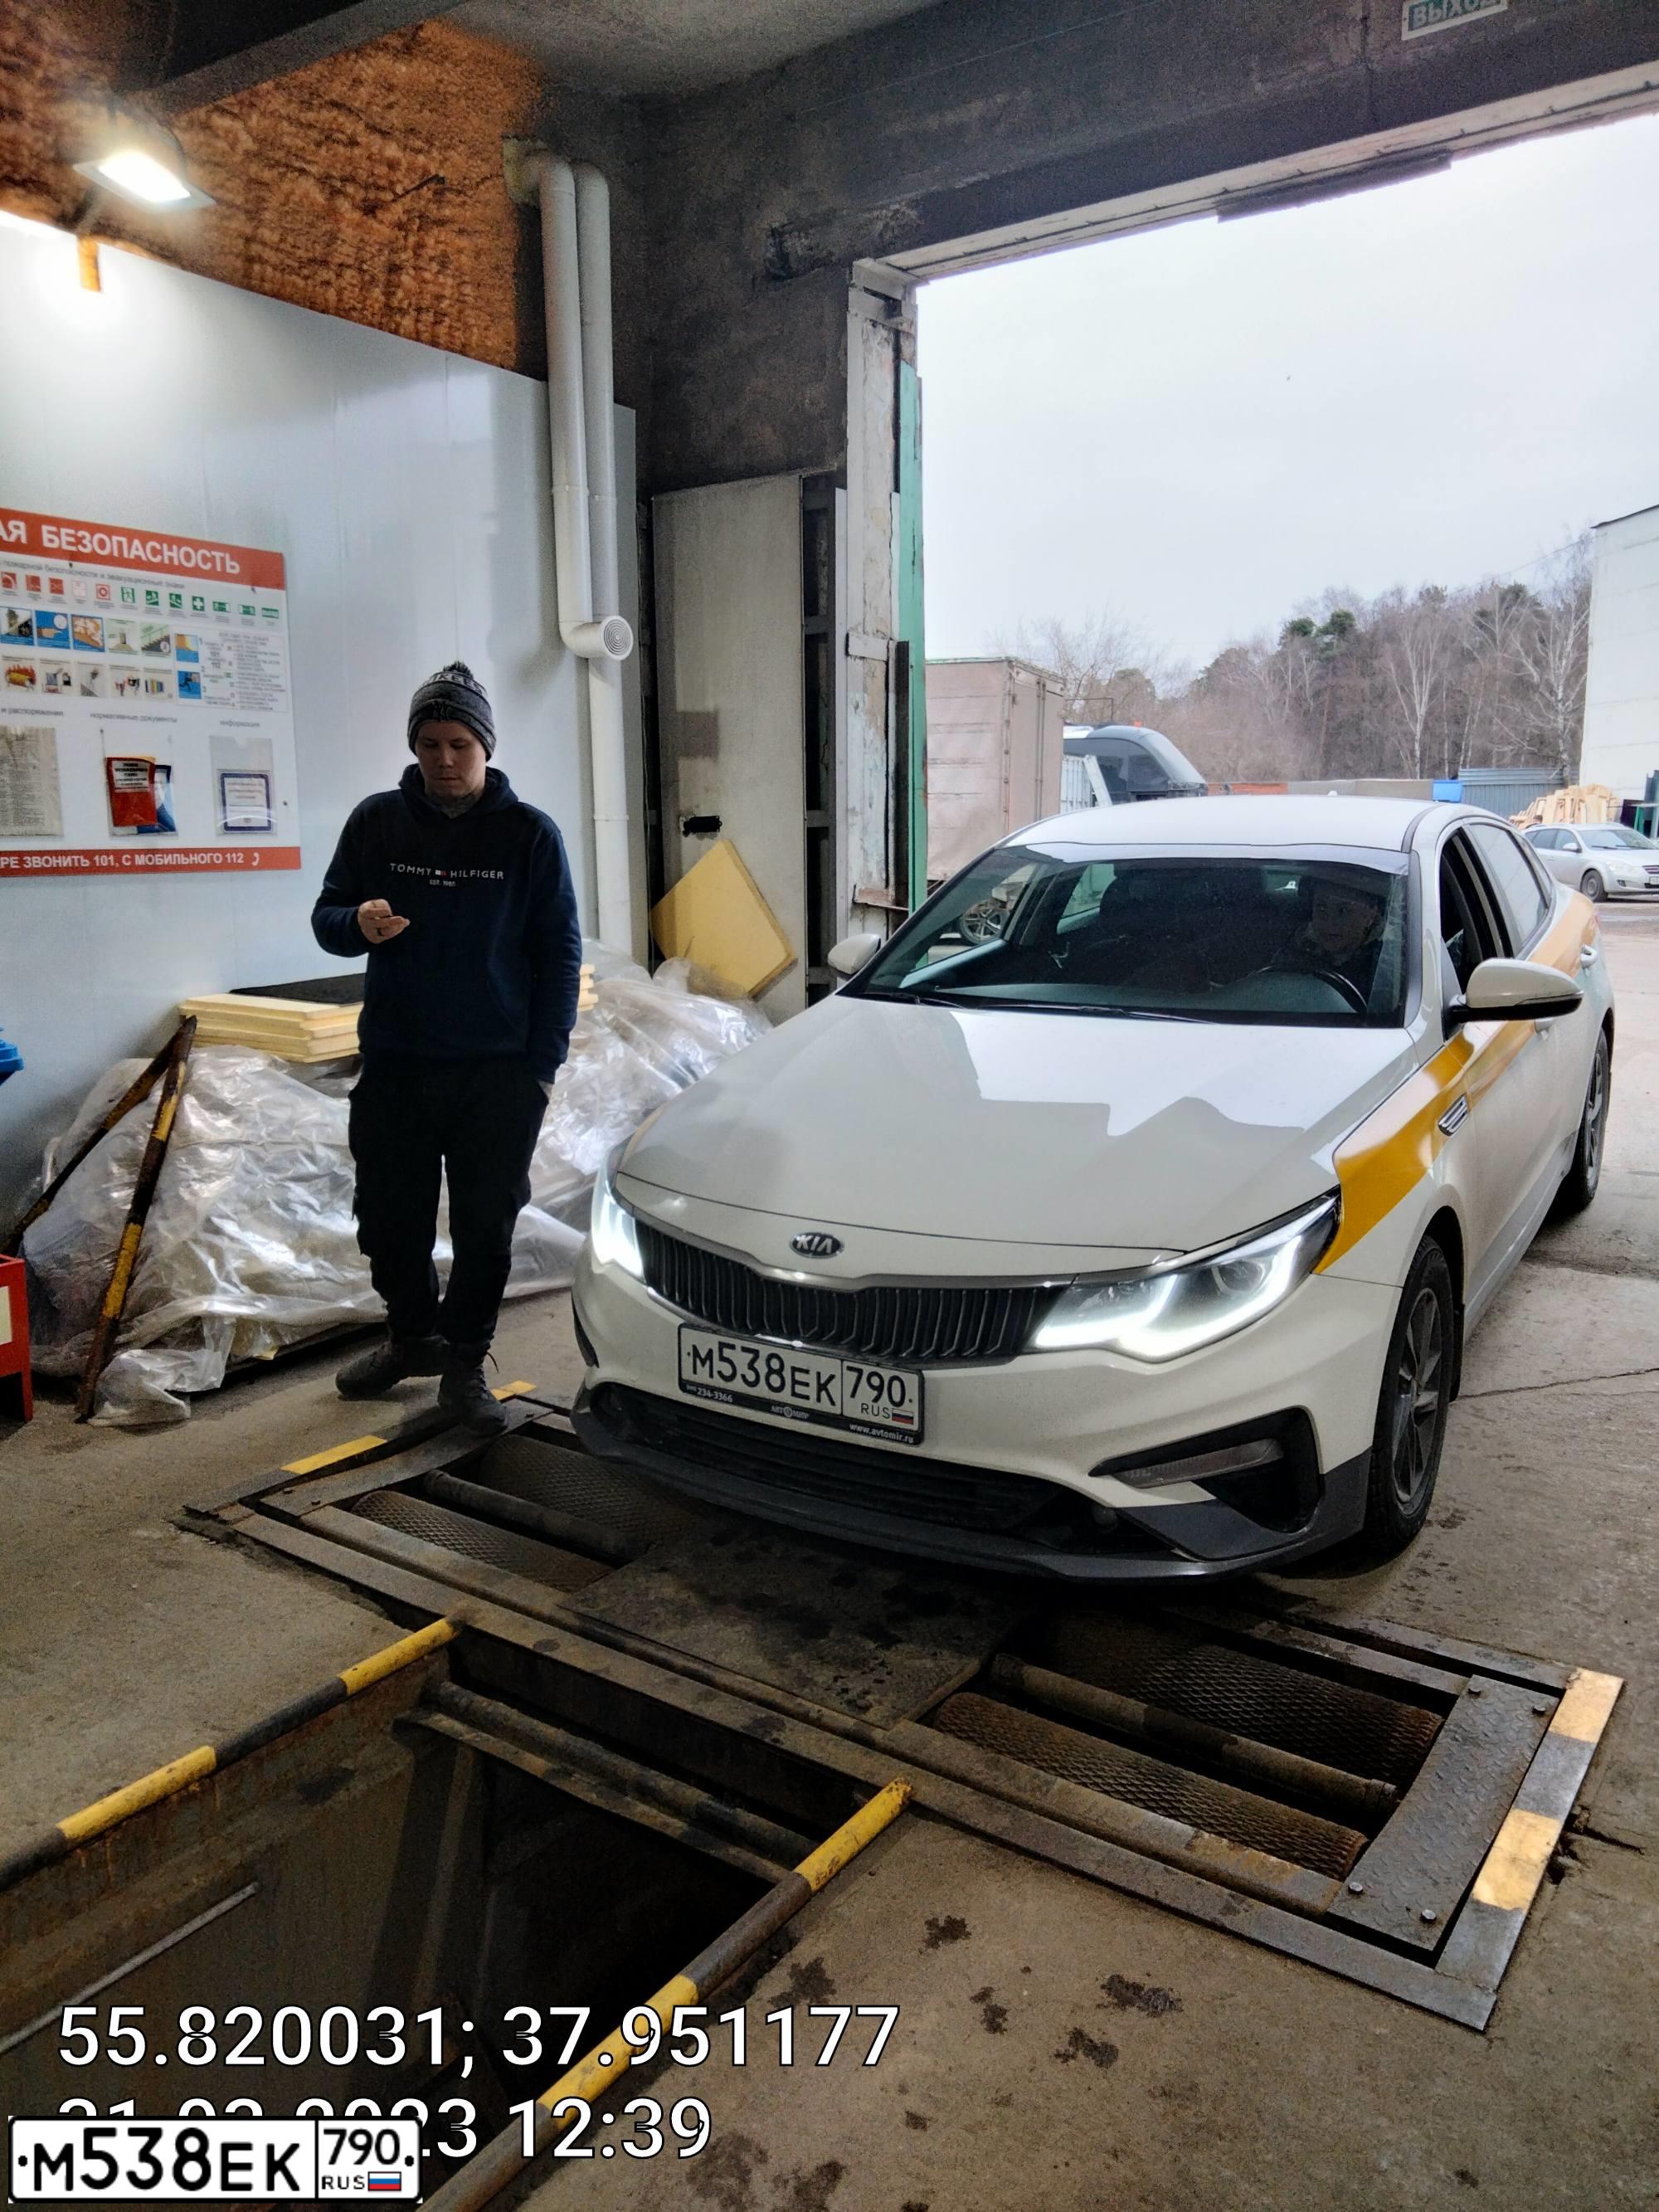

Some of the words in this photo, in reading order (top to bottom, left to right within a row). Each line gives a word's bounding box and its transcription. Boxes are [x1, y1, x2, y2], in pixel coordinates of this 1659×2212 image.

[1413, 0, 1495, 28] ВЫХО
[41, 524, 241, 574] БЕЗОПАСНОСТЬ
[23, 855, 90, 868] ЗВОНИТЬ
[122, 854, 131, 865] С
[135, 853, 222, 865] МОБИЛЬНОГО
[226, 852, 244, 864] 112
[390, 863, 431, 875] TOMMY
[450, 870, 504, 879] HILFIGER
[796, 1235, 833, 1254] KIA
[692, 1341, 836, 1406] М538ЕК
[846, 1366, 906, 1408] 790
[861, 1403, 890, 1419] RUS
[849, 1424, 914, 1443] www.avtomir.ru
